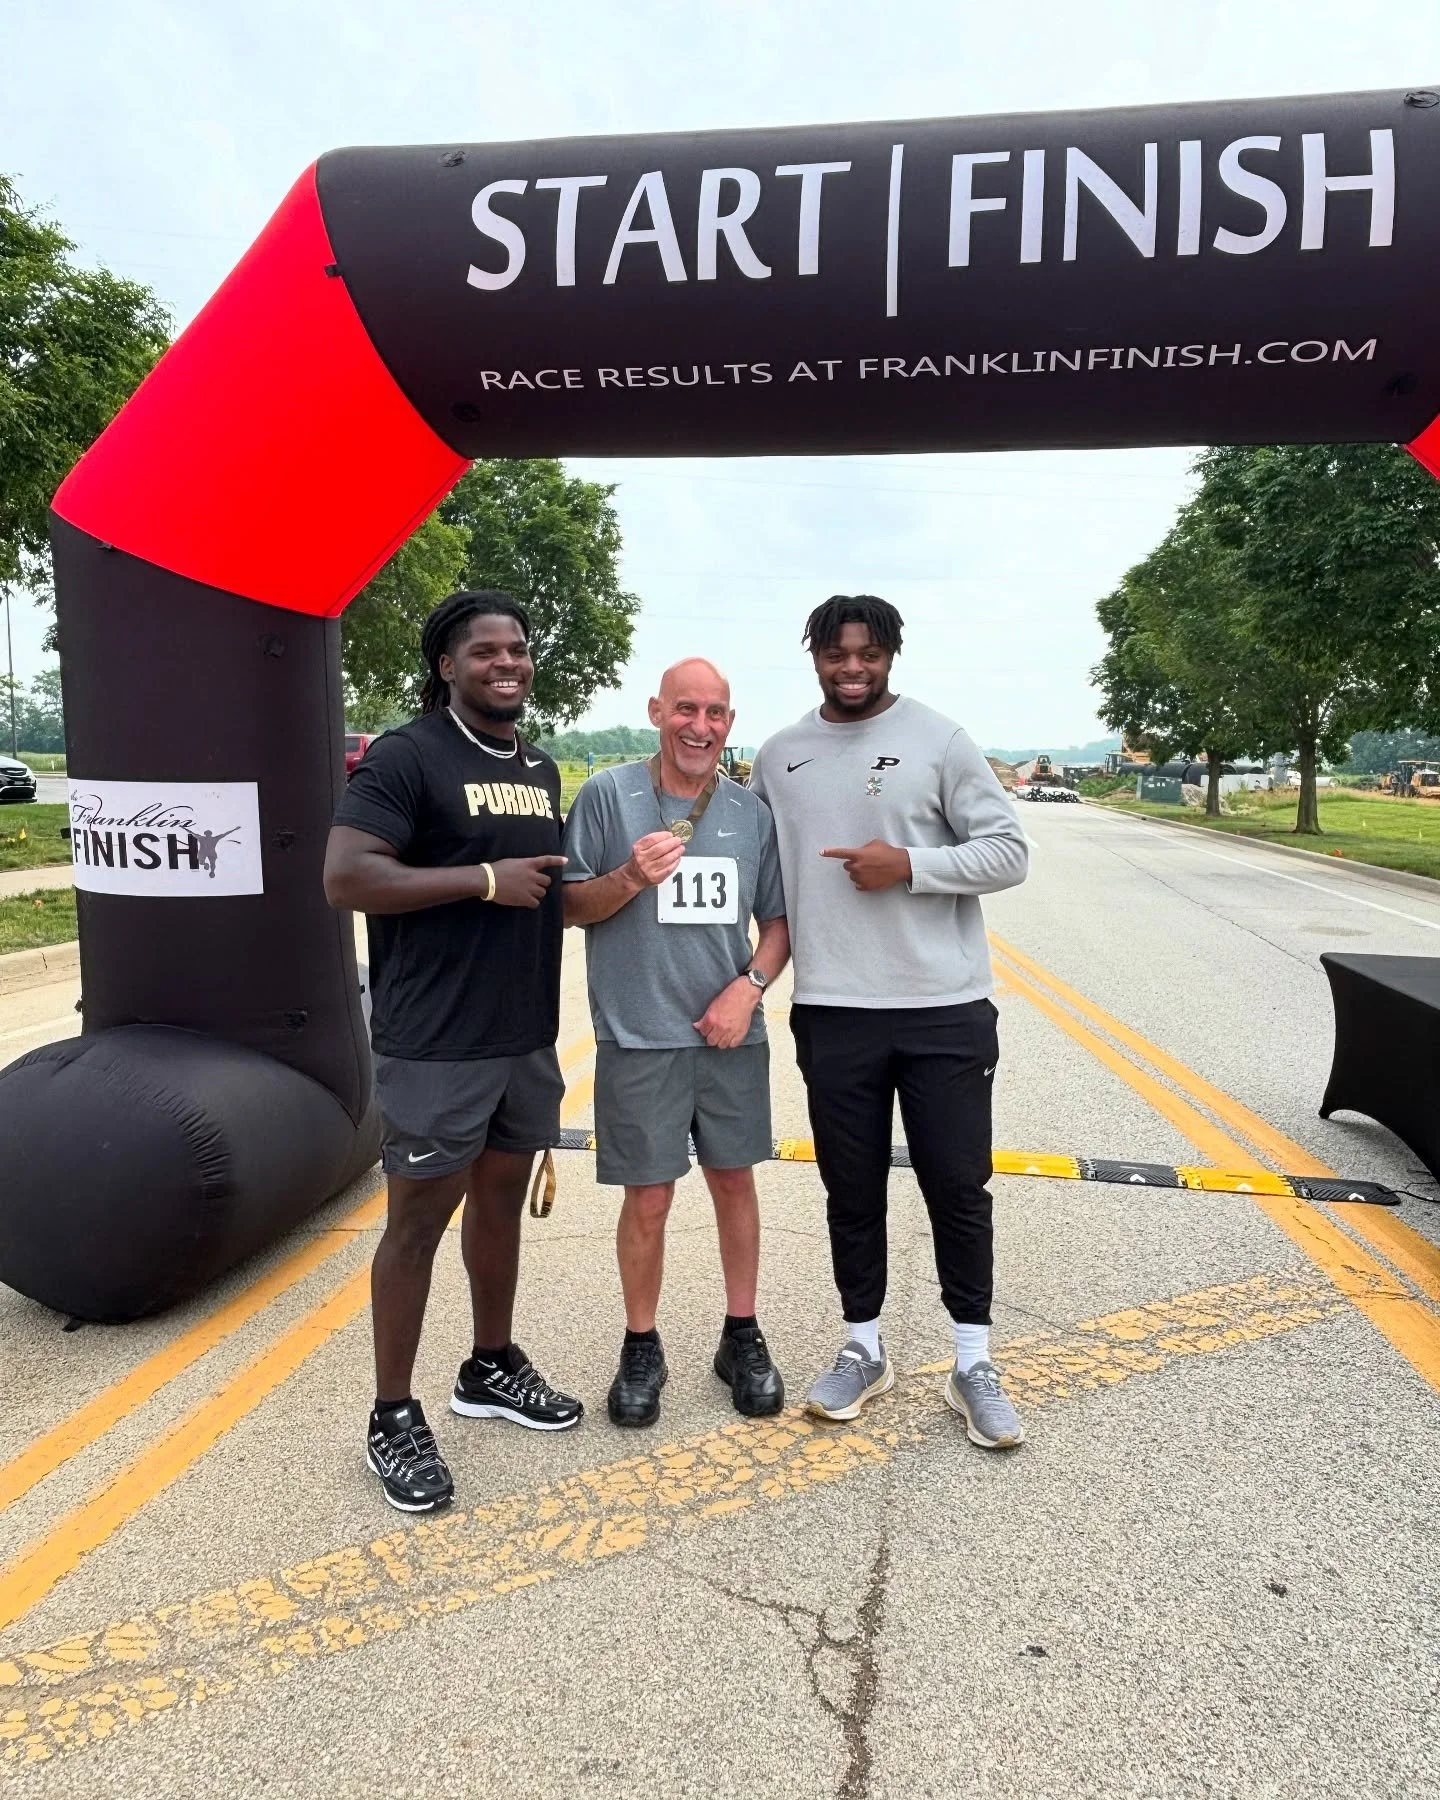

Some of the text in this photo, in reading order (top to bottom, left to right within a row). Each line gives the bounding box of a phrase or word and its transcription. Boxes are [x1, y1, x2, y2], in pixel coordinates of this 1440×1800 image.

[467, 128, 1396, 291] START FINISH
[480, 338, 1377, 391] RACE RESULTS AT FRANKLINFINISH.COM
[870, 756, 901, 771] P
[71, 793, 197, 829] Franklin
[463, 782, 555, 820] PURDUE
[73, 827, 200, 870] FINISH
[672, 871, 727, 909] 113
